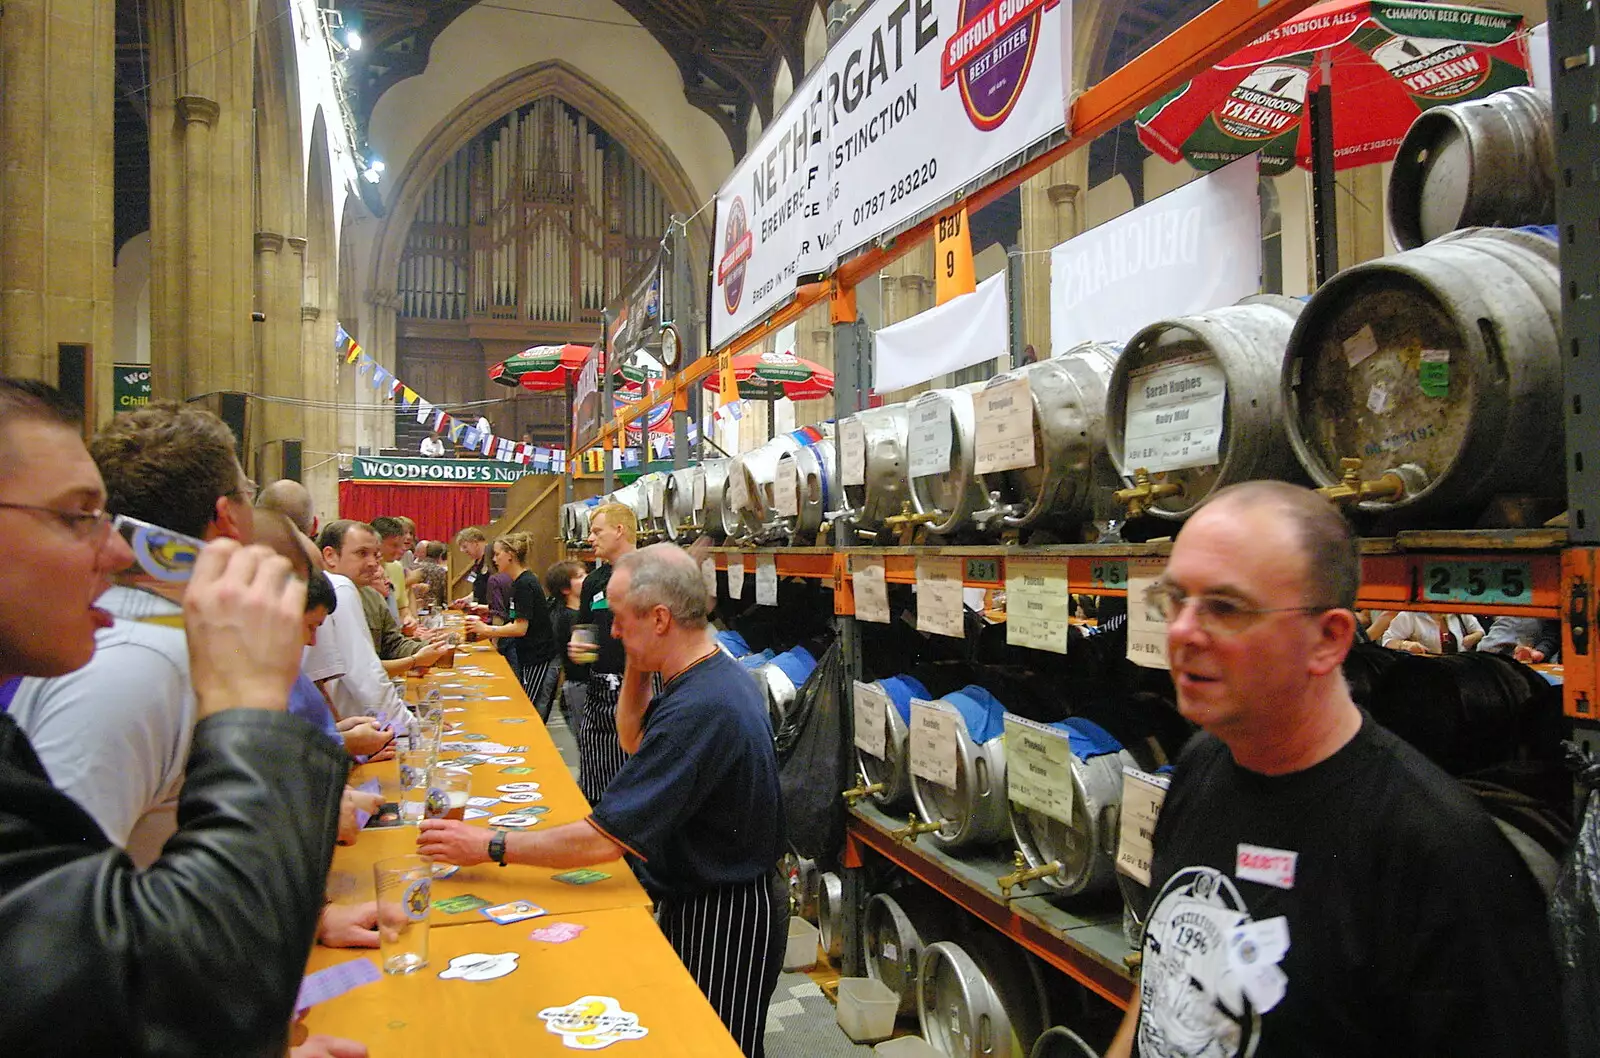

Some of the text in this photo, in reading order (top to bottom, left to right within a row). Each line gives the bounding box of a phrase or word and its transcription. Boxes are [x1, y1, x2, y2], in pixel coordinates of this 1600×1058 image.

[1282, 17, 1330, 37] NORFOLK
[1332, 12, 1358, 26] ALES
[1436, 11, 1459, 22] BEER
[1460, 12, 1472, 23] OF
[949, 8, 997, 66] SUFFOLK
[969, 27, 1027, 82] BEST BITTER
[853, 158, 937, 226] 01787 283220
[939, 210, 962, 243] Bay
[946, 250, 954, 278] 9
[1145, 376, 1203, 399] Sarah Hughes
[361, 461, 491, 481] WOODFORDE'S
[1094, 564, 1128, 585] 25
[1429, 566, 1525, 598] 255
[1176, 926, 1208, 956] 1996
